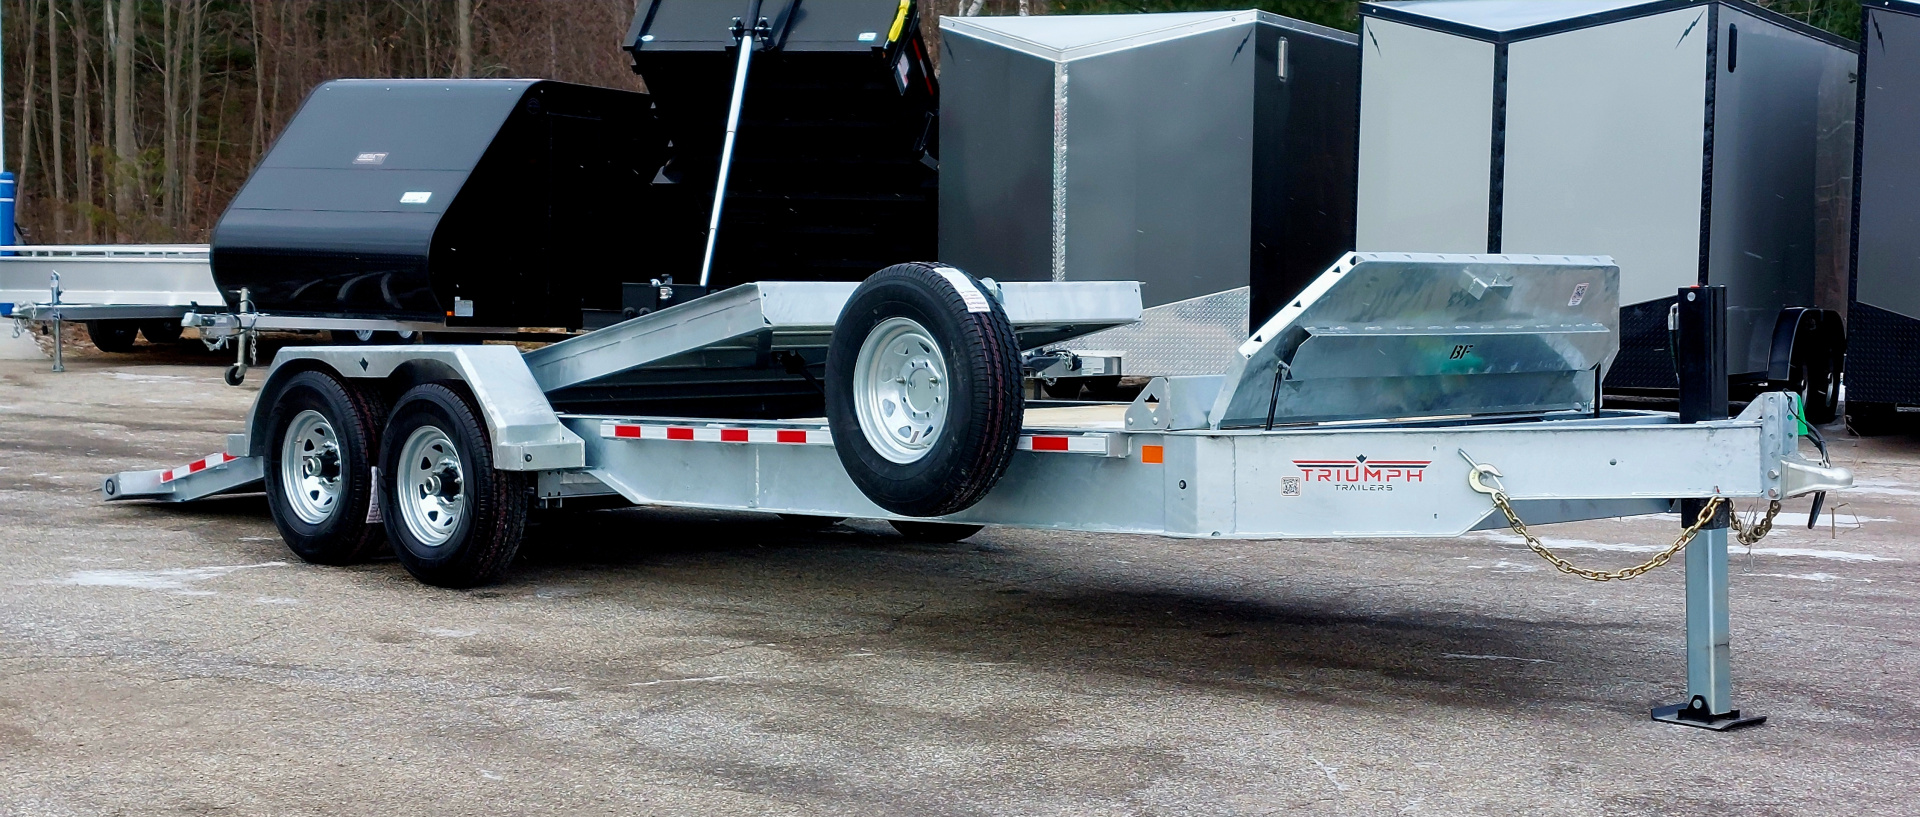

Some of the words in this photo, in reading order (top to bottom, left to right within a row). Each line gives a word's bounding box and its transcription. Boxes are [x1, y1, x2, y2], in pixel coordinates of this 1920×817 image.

[1449, 344, 1474, 359] BF
[1300, 466, 1424, 483] TRIUMPH
[1334, 484, 1394, 492] TRAILERS
